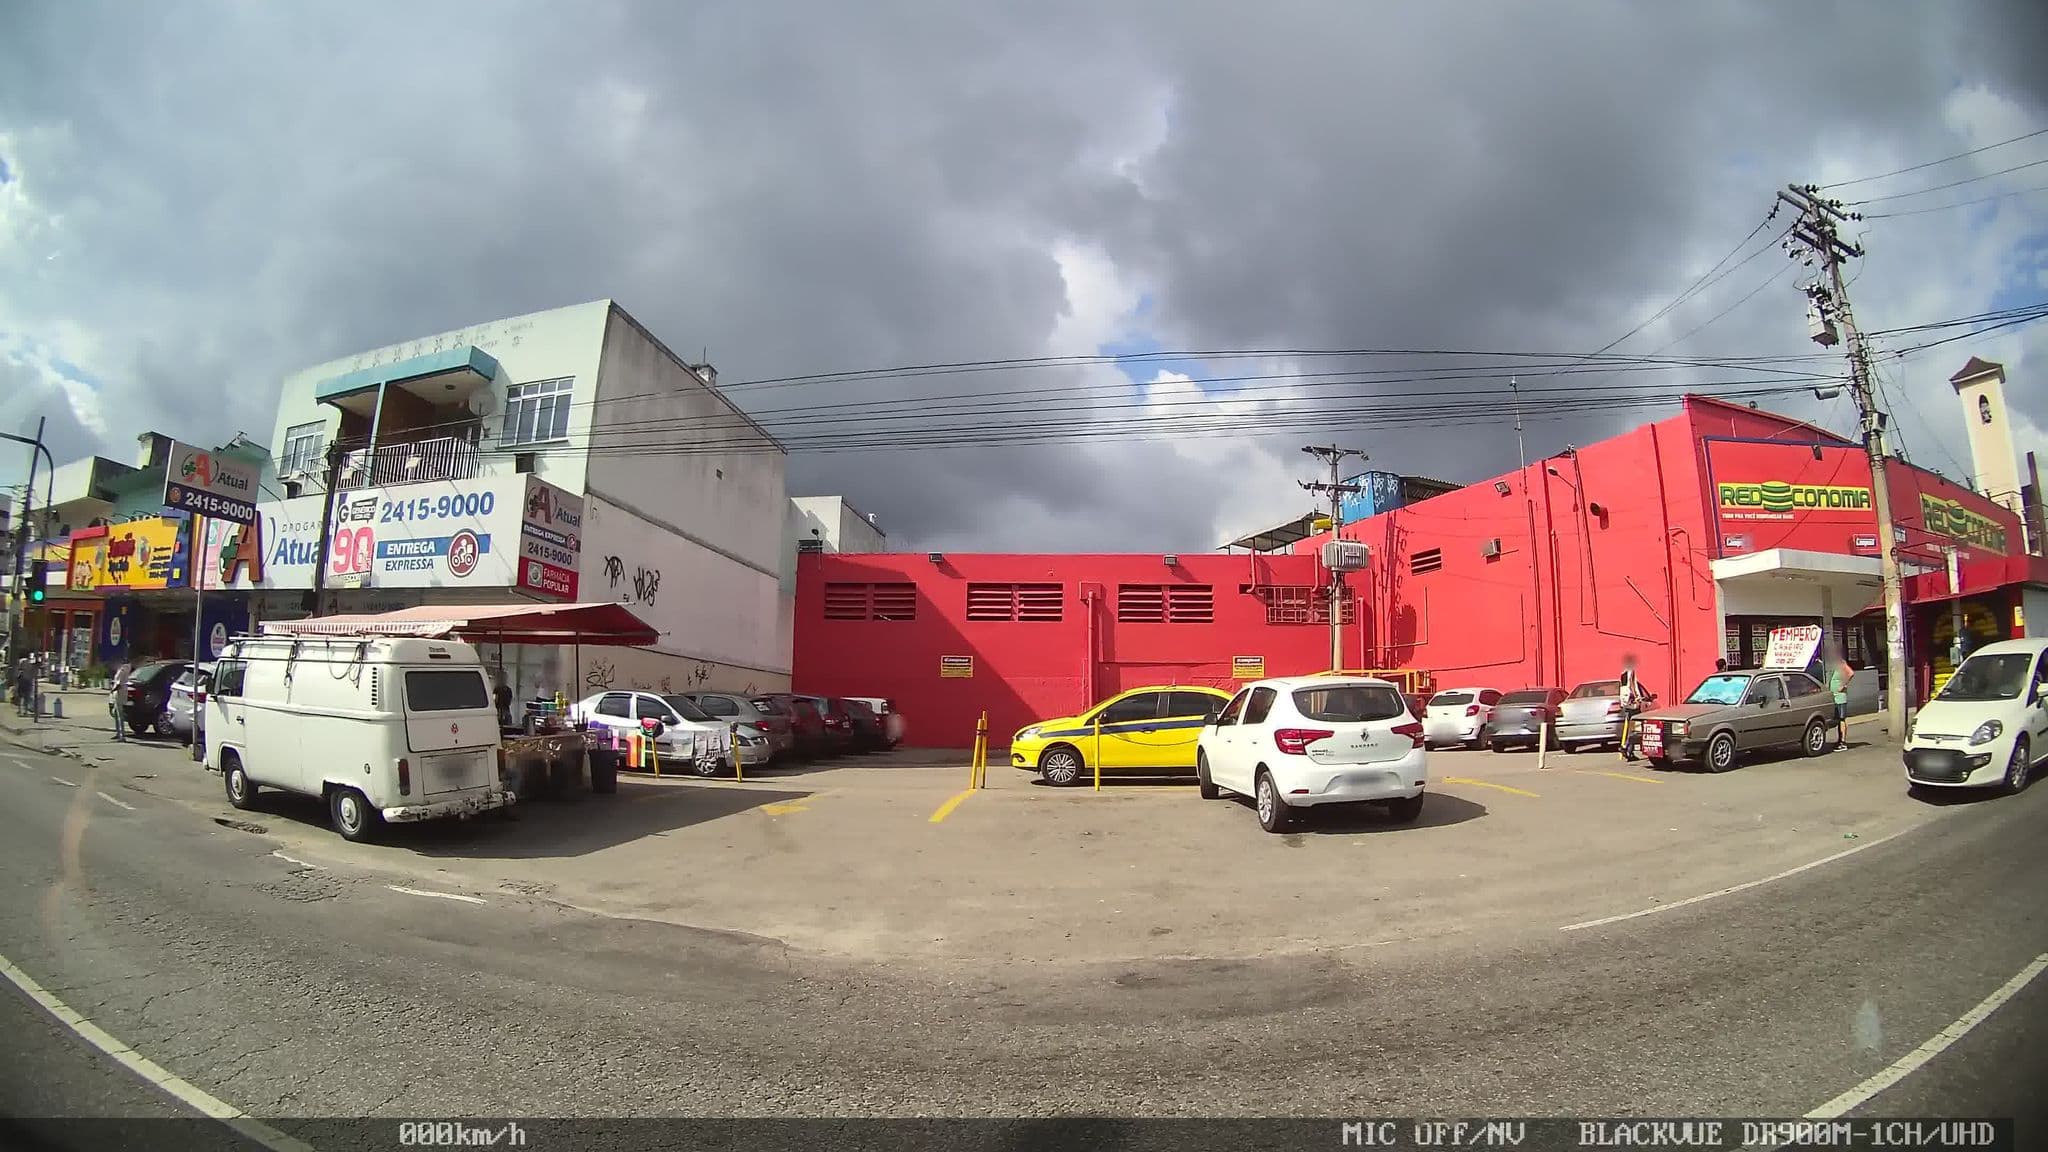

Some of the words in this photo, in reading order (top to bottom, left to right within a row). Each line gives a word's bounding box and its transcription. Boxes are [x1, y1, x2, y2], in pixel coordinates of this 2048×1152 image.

[217, 472, 249, 491] Atual
[184, 491, 254, 521] 2415-9000
[380, 491, 495, 523] 2415-9000
[555, 506, 581, 529] Atual
[272, 536, 322, 565] Atua
[386, 540, 436, 556] ENTREGA
[527, 541, 573, 566] 2415-9000
[385, 558, 435, 572] EXPRESSA
[542, 579, 570, 594] POPULAR
[1770, 626, 1818, 642] TEMPERO
